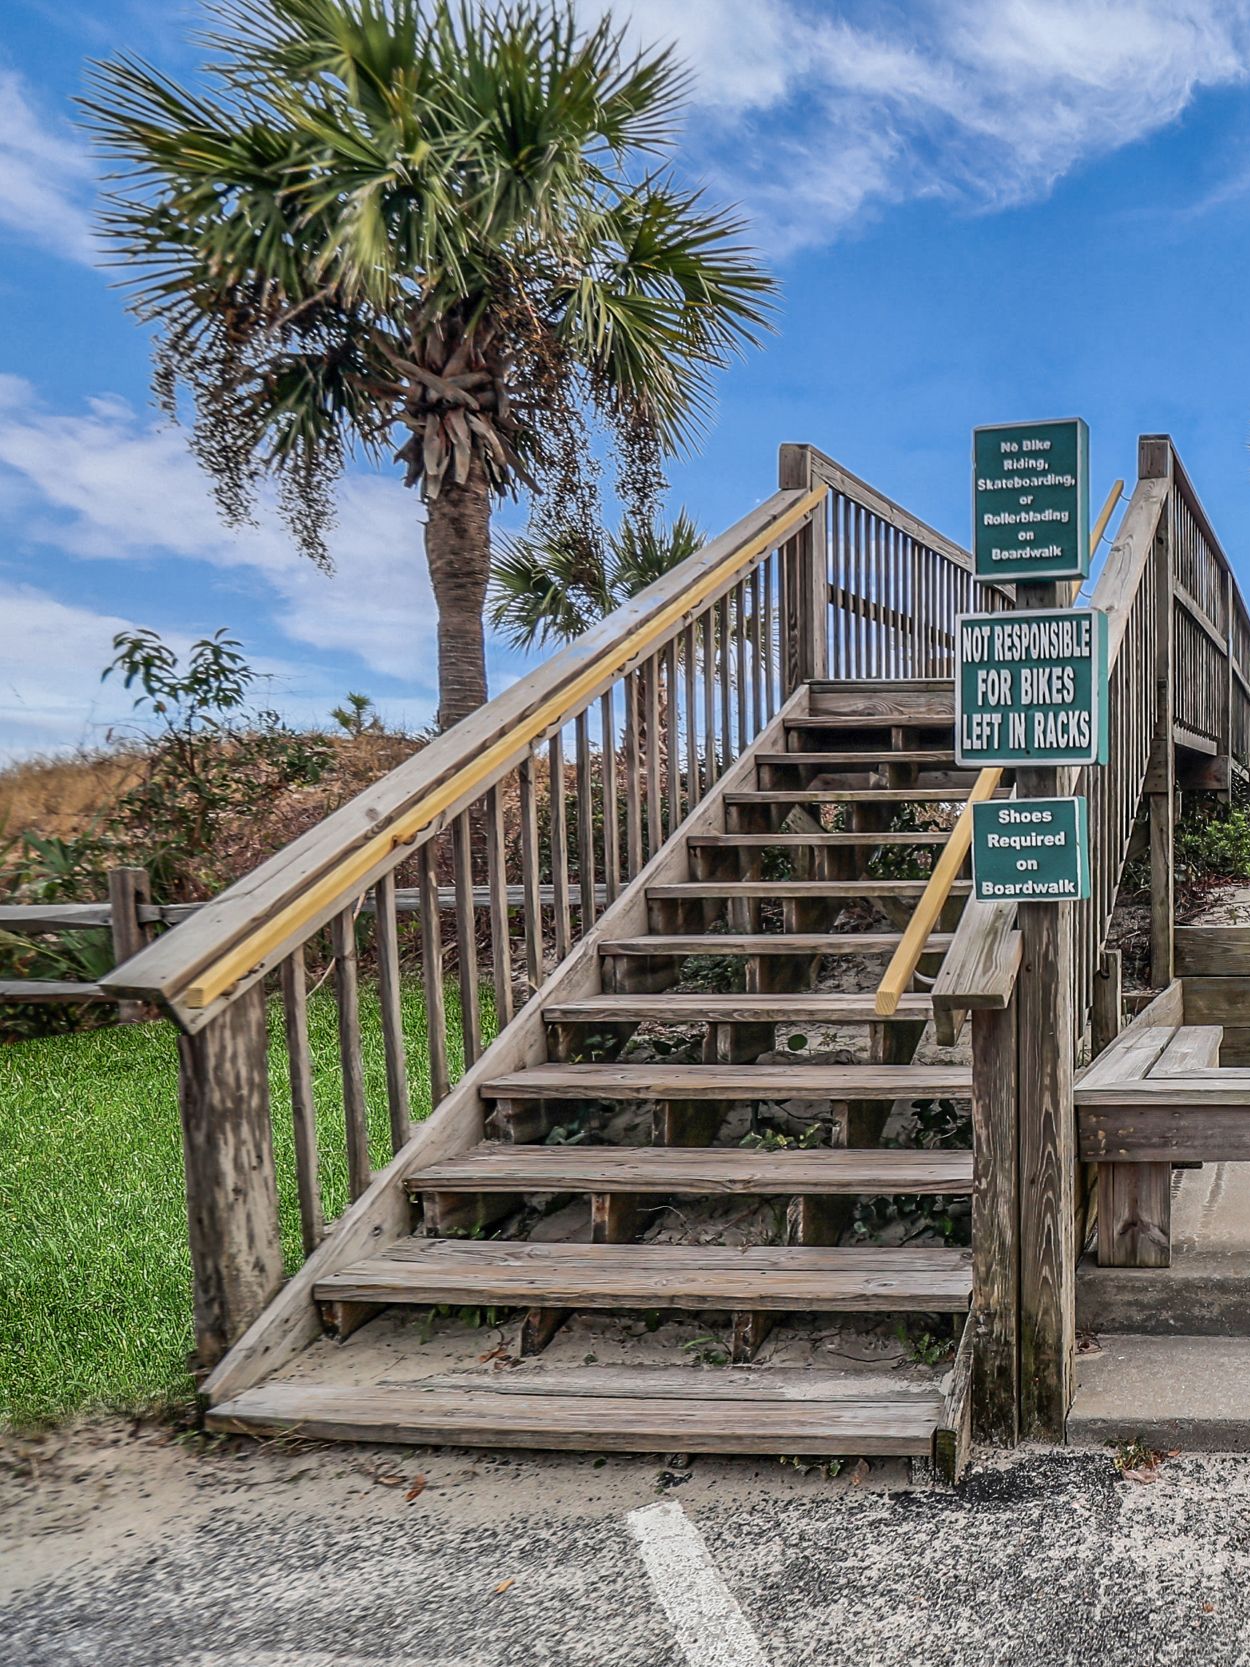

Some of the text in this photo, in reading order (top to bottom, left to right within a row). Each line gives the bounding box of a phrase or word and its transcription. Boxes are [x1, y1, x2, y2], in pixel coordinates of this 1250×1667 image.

[1000, 440, 1051, 453] No Bike
[1004, 458, 1048, 470] Riding,
[978, 474, 1075, 490] Skateboarding,
[1019, 495, 1033, 505] or
[984, 509, 1069, 526] Rollerblading
[1018, 531, 1034, 541] on
[991, 545, 1062, 560] Boardwalk
[962, 620, 1090, 663] NOT RESPONSIBLE
[977, 666, 1075, 706] FOR BIKES
[962, 710, 1090, 750] LEFT IN RACKS
[998, 810, 1052, 824] Shoes
[987, 831, 1065, 850] Required
[1016, 859, 1038, 870] on
[981, 879, 1076, 895] Boardwalk
